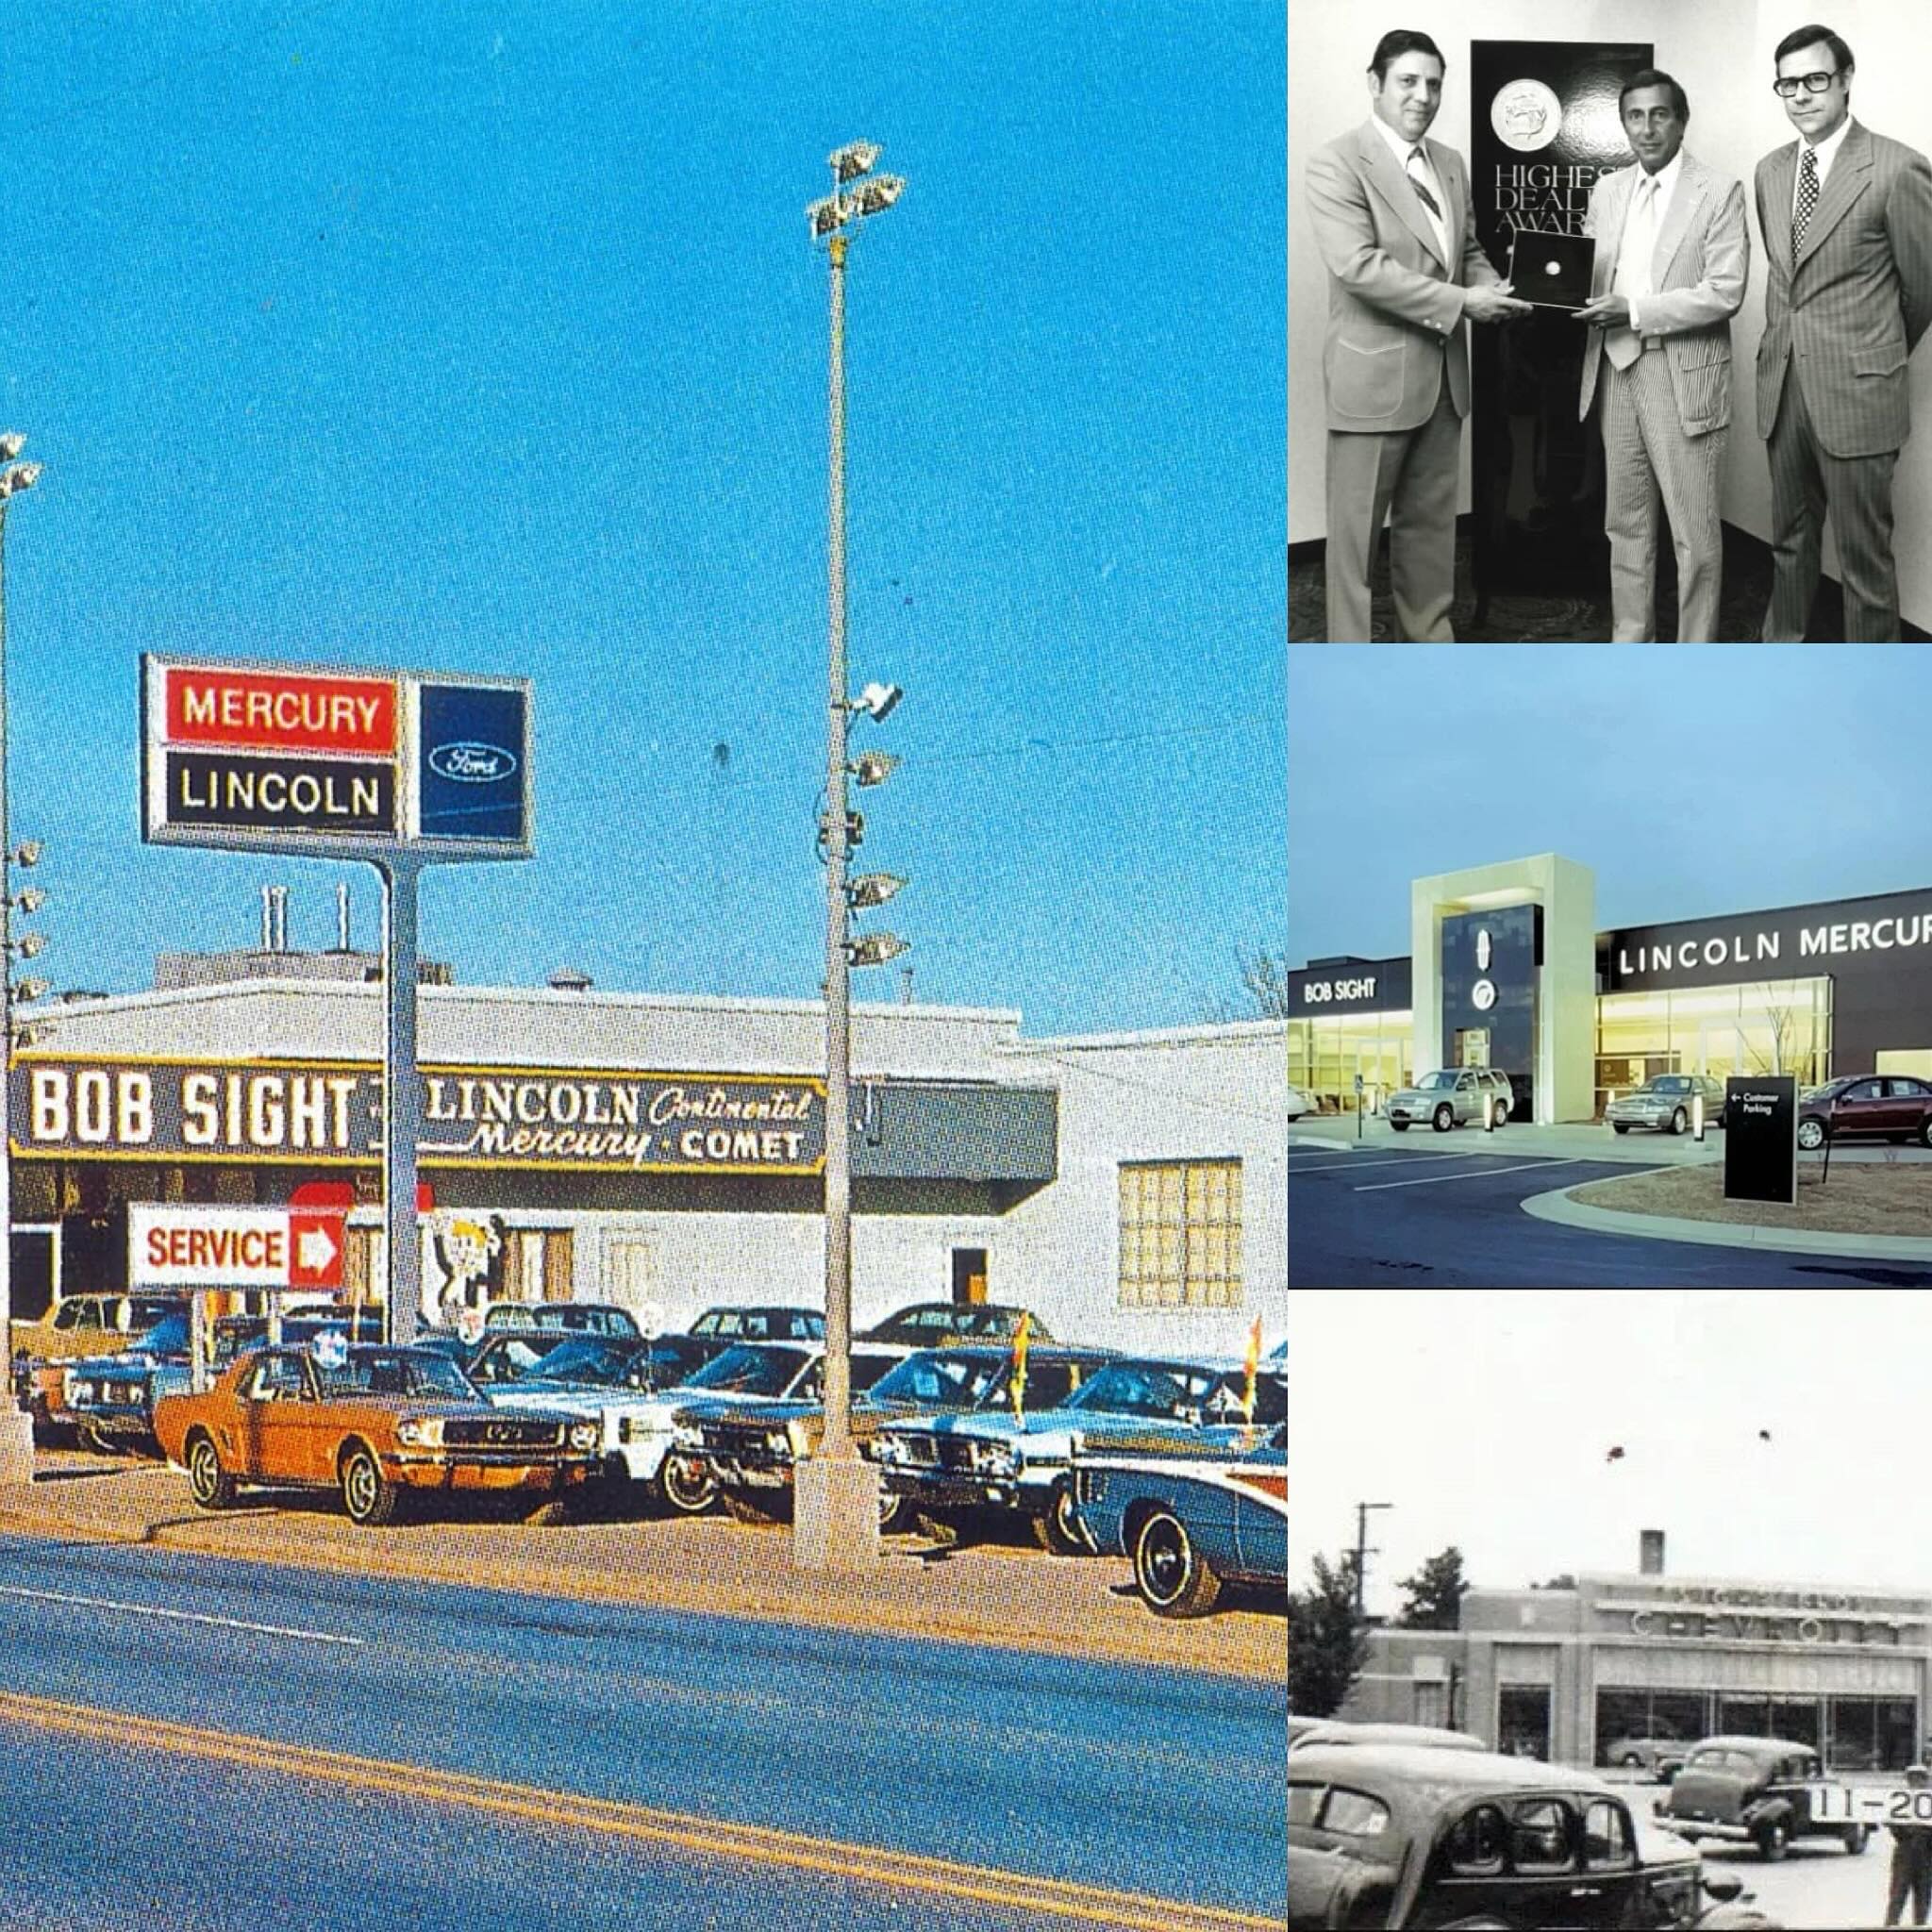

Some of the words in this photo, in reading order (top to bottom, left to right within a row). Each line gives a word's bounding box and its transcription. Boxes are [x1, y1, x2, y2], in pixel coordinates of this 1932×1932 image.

[1495, 164, 1618, 189] HIGHE
[1495, 188, 1591, 211] DEAL
[1495, 210, 1587, 235] AWAR
[181, 685, 381, 734] MERCURY
[445, 749, 499, 774] Ford
[180, 768, 379, 816] LINCOLN
[1620, 930, 1780, 974] LINCOLN
[1305, 983, 1332, 1003] BOB
[1335, 977, 1376, 1001] SIGHT
[30, 1069, 154, 1142] BOB
[182, 1073, 358, 1148] SIGHT
[426, 1078, 641, 1124] LINCOLN
[648, 1087, 812, 1124] Continental
[1742, 1092, 1779, 1103] Customer
[1742, 1104, 1772, 1115] Parking
[470, 1120, 653, 1167] Mercury
[680, 1131, 805, 1159] COMET
[147, 1226, 285, 1268] SERVICE
